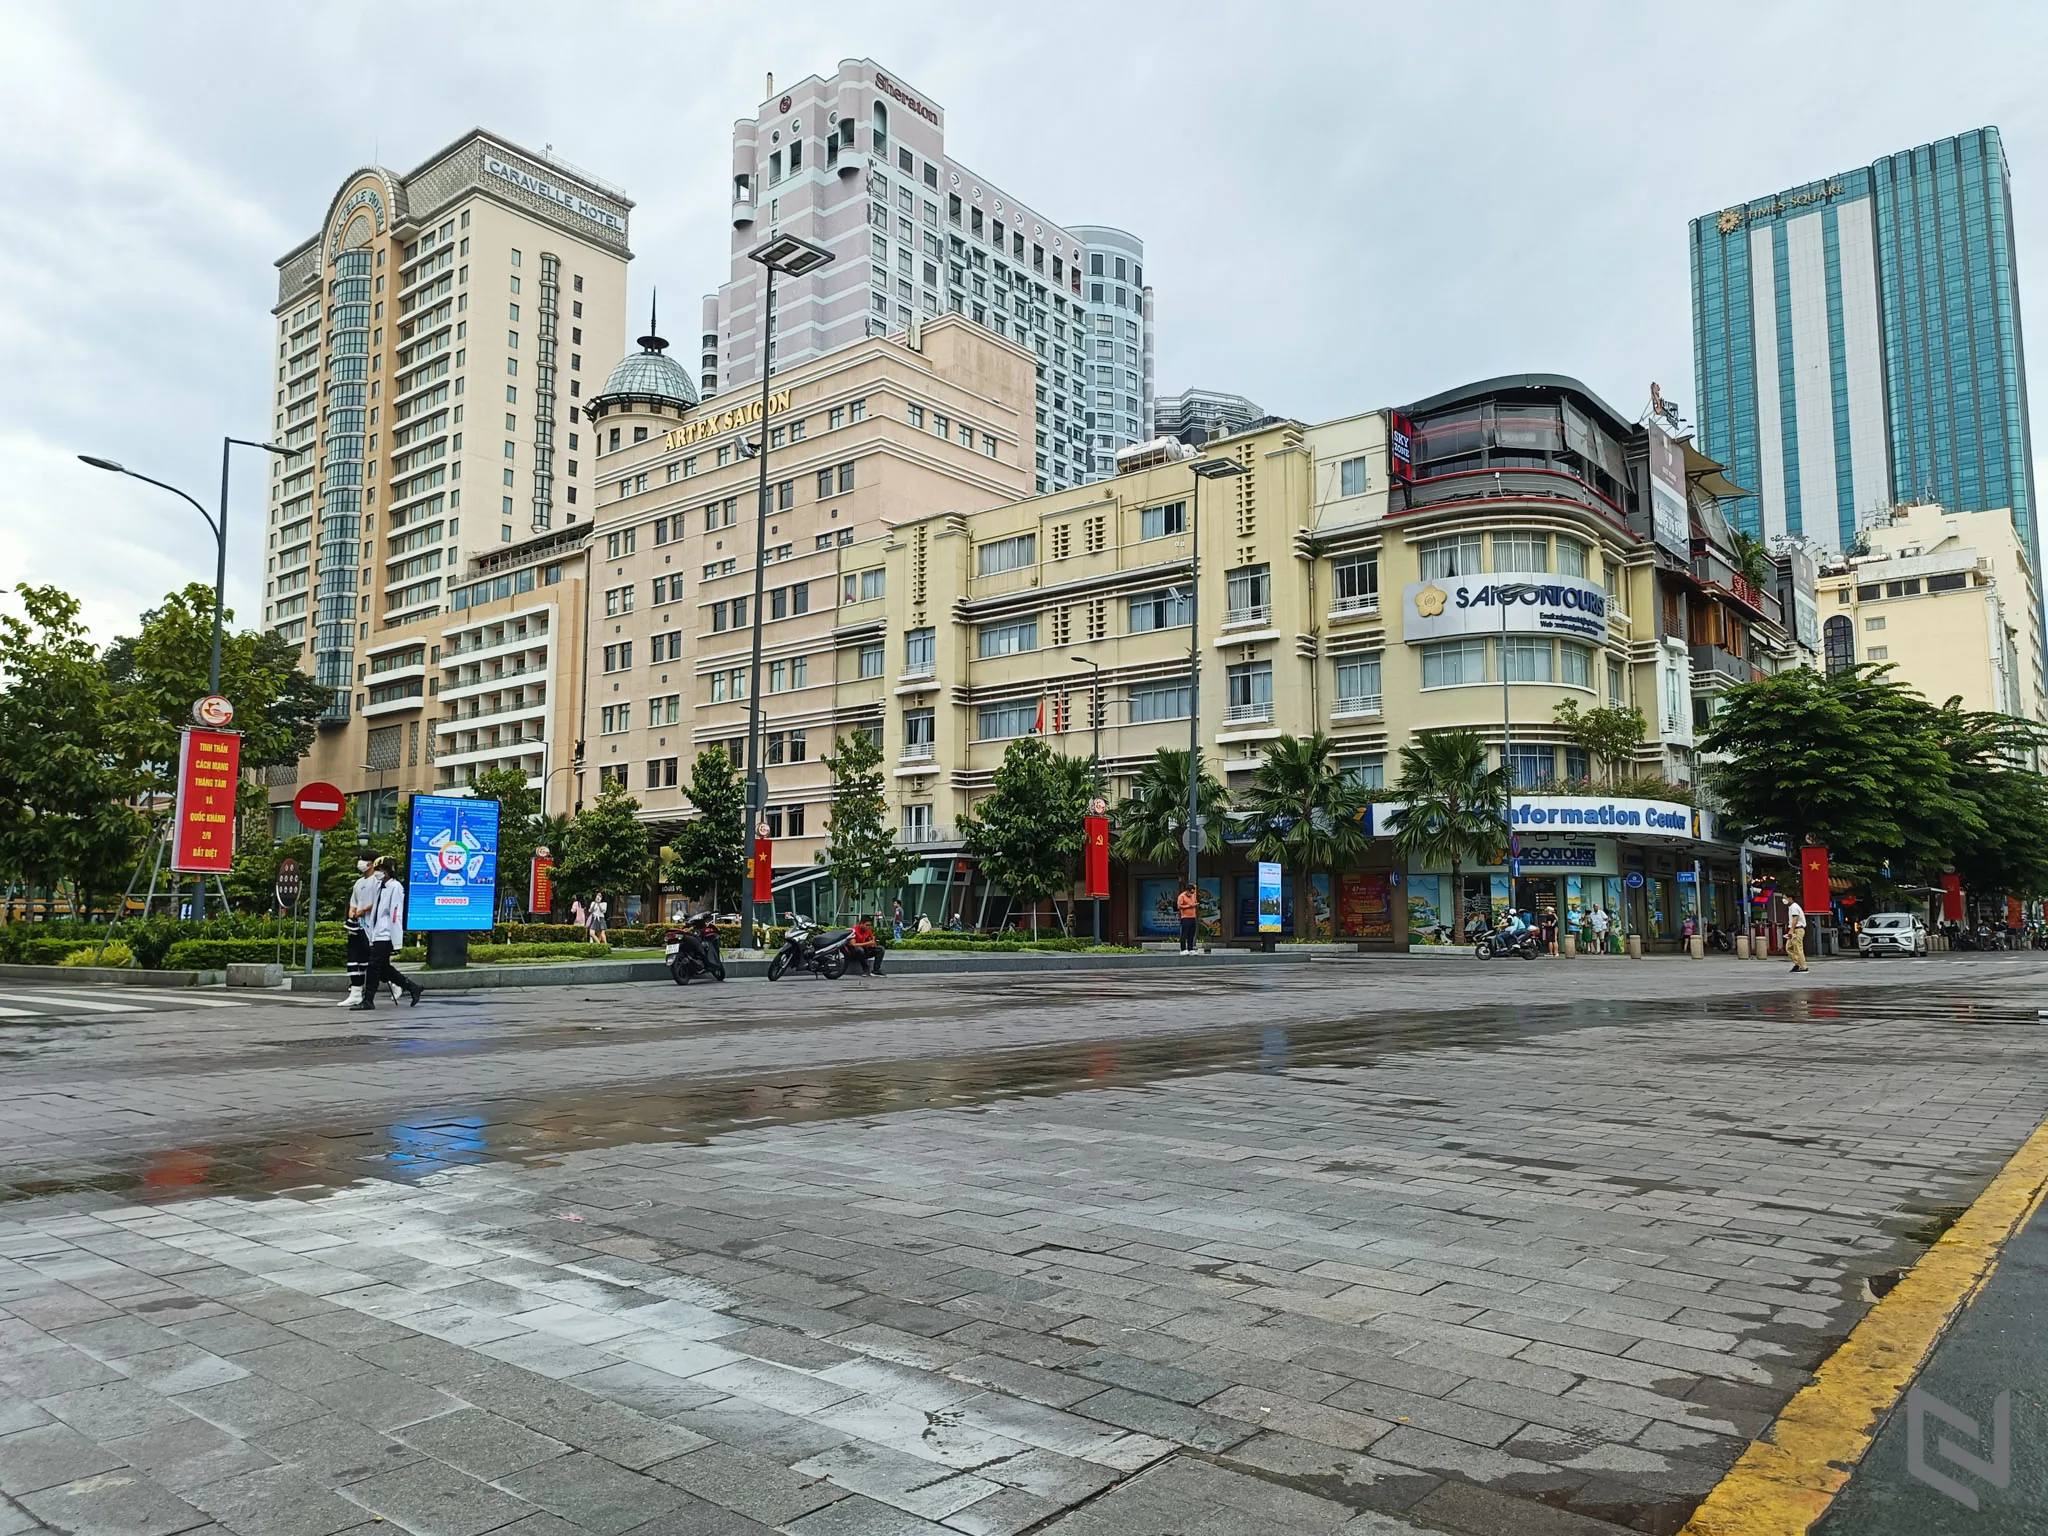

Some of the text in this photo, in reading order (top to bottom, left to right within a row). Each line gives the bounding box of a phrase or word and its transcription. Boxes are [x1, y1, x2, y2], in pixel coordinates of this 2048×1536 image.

[874, 71, 938, 126] Sheraton
[488, 159, 622, 231] CARAVELLE HOTEL
[1747, 183, 1845, 221] TIMES SQUARE
[663, 389, 791, 452] ARTEX SAIGON
[1393, 430, 1409, 448] SKY
[1394, 442, 1410, 458] ZONE
[1456, 583, 1605, 618] SAIGONTOURIST
[199, 742, 213, 752] TINH
[195, 758, 211, 770] CÁCH
[1503, 804, 1640, 825] nformation
[447, 855, 462, 866] 5K
